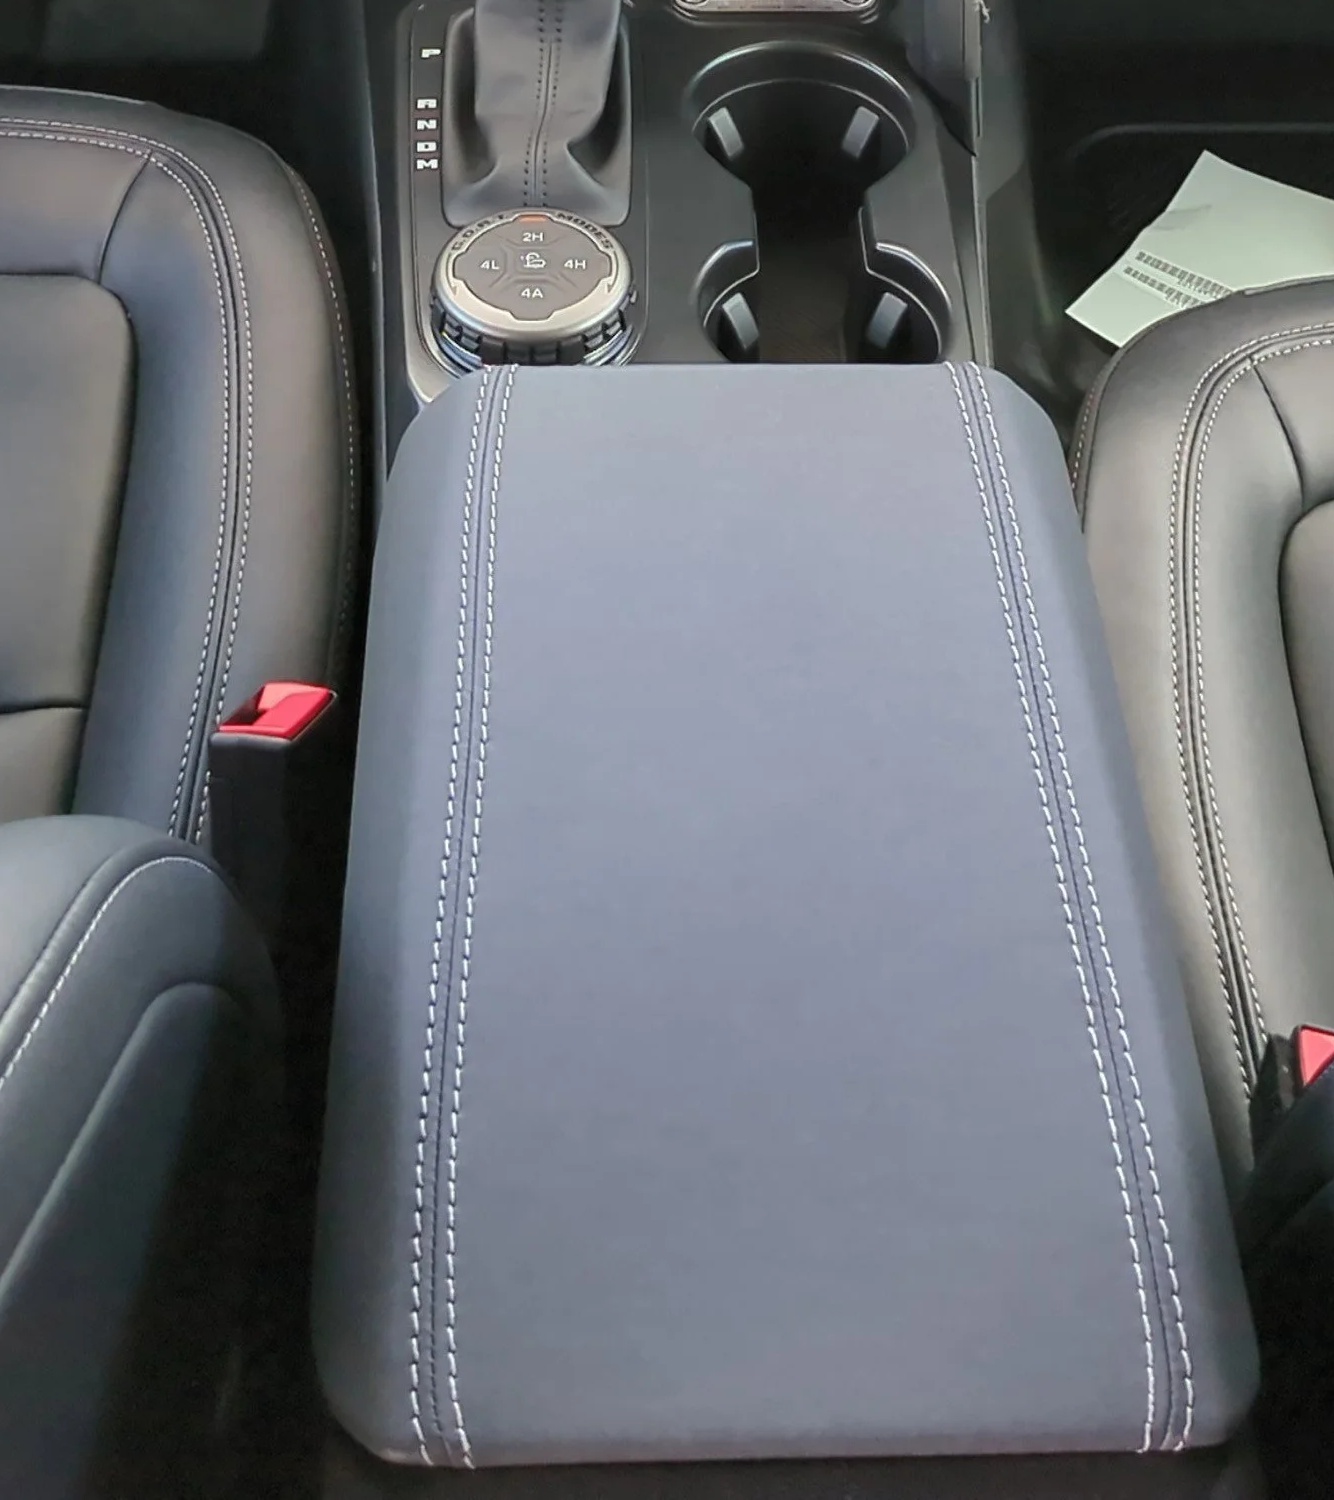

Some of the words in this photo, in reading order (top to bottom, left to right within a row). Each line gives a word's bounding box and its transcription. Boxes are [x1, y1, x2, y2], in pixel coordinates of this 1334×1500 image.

[417, 120, 437, 130] N
[416, 141, 437, 152] D
[416, 159, 438, 170] M
[556, 212, 614, 250] MODES
[522, 232, 544, 242] 2H
[480, 260, 500, 270] 4L
[563, 259, 586, 270] 4H
[520, 287, 544, 299] 4A
